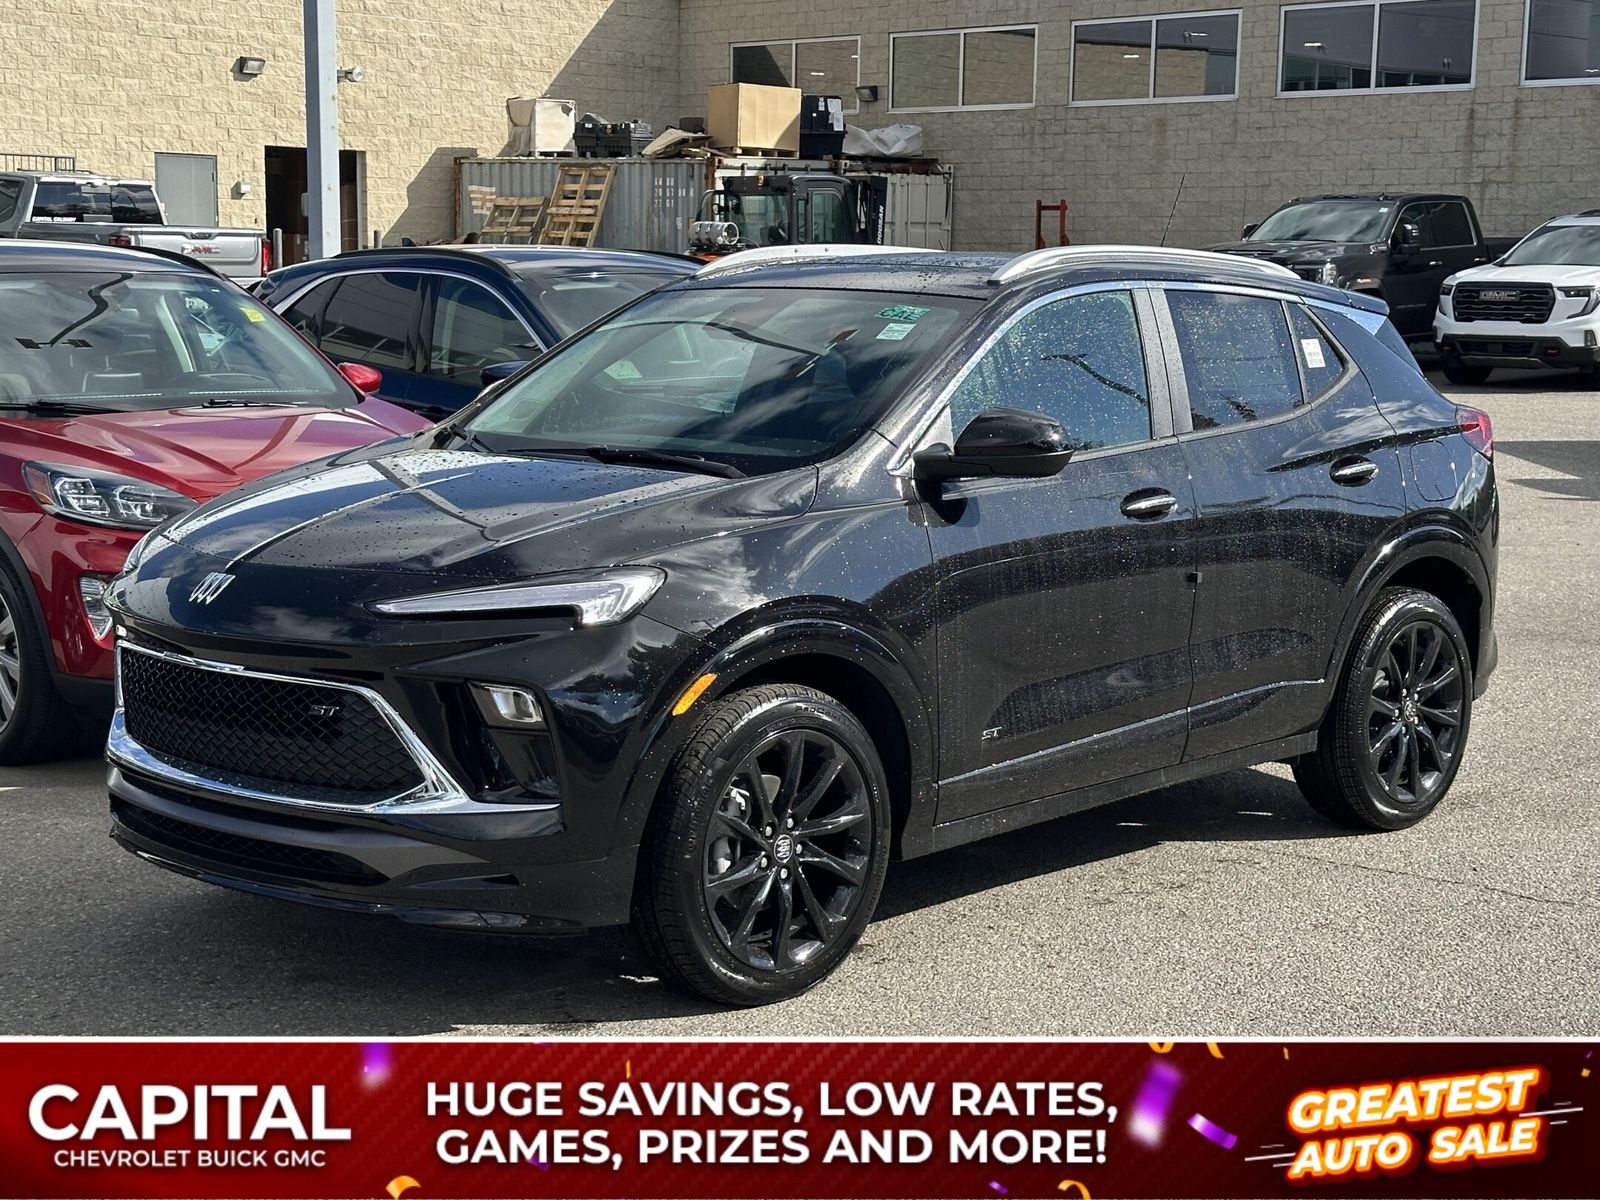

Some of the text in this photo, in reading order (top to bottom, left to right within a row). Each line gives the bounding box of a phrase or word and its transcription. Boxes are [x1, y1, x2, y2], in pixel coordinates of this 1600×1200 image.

[876, 204, 885, 245] DOOSAN
[310, 704, 340, 716] ST
[981, 726, 1003, 740] ST
